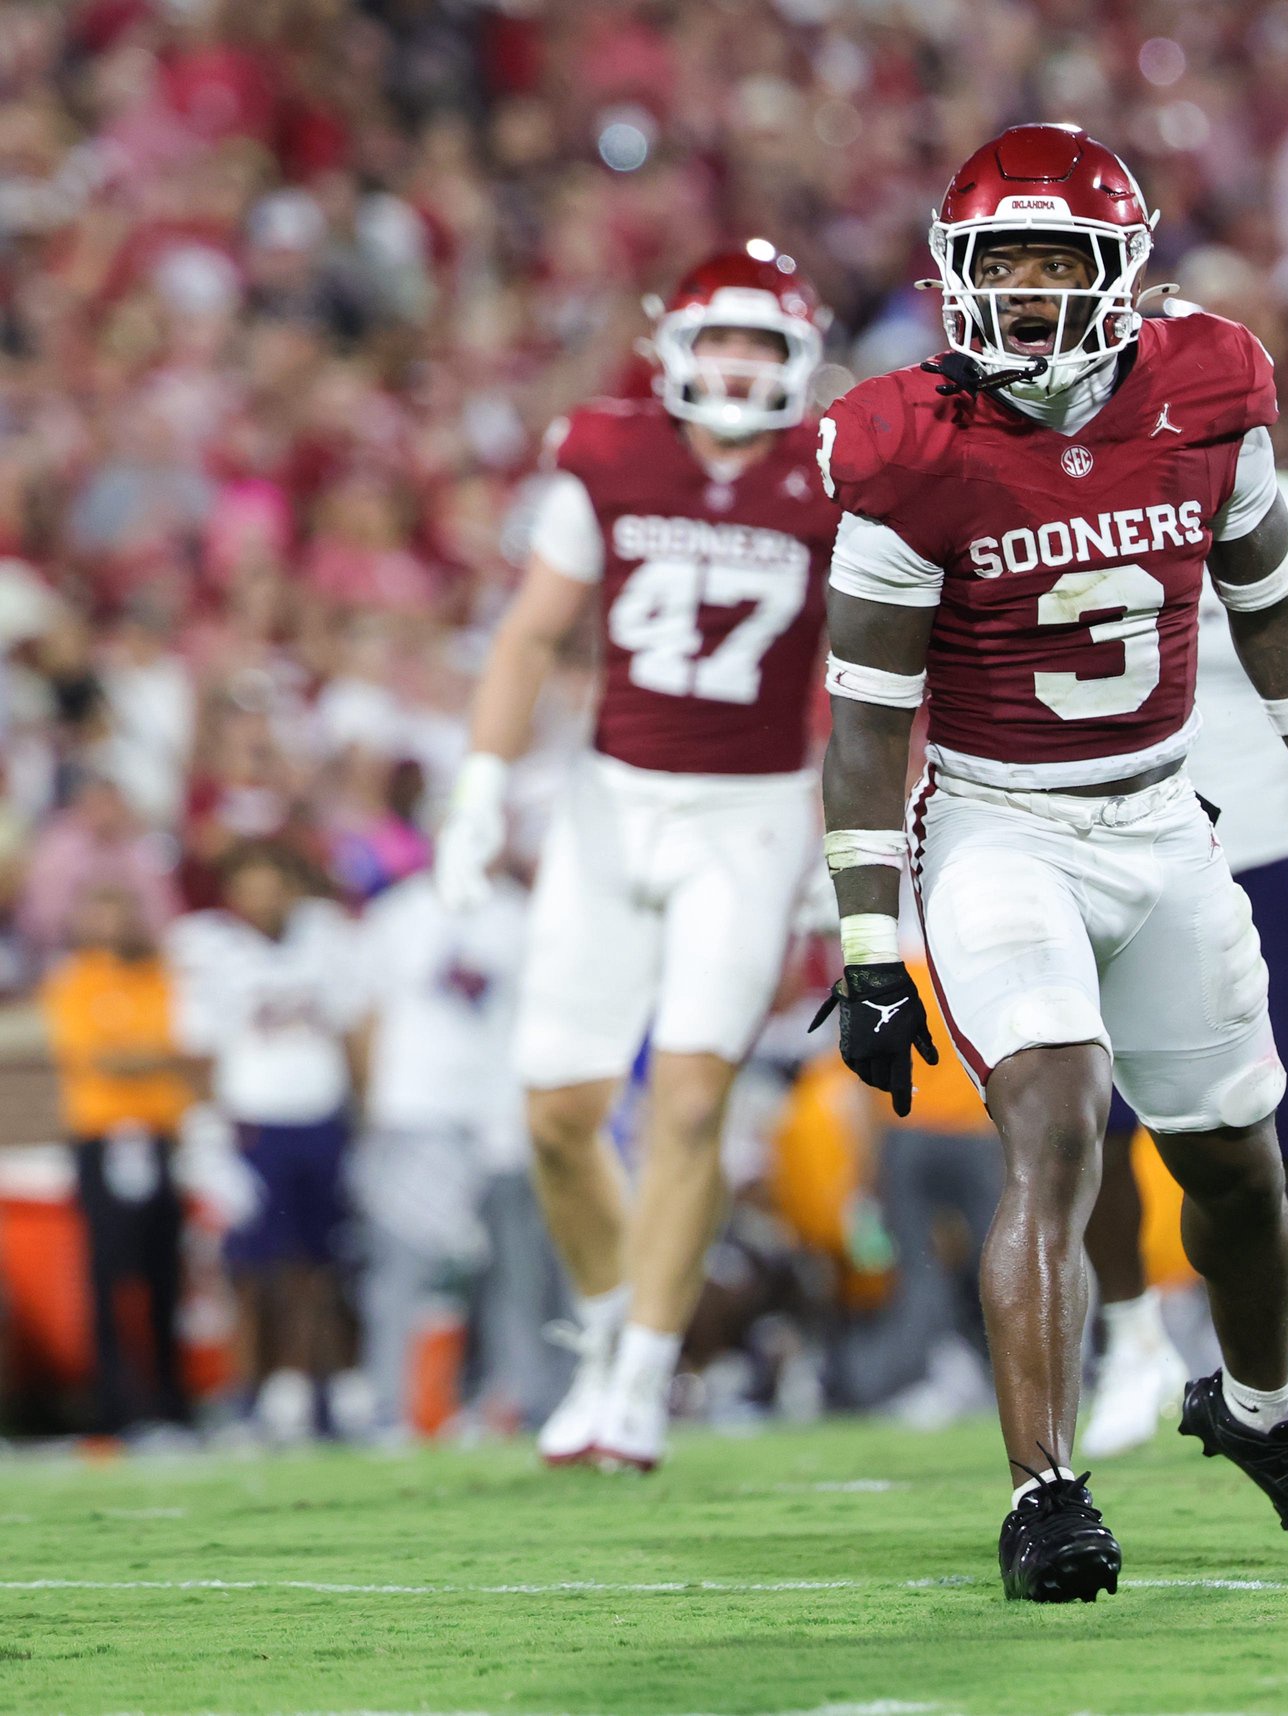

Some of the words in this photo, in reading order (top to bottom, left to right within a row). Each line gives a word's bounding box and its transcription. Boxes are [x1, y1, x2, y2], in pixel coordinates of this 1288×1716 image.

[1011, 200, 1055, 210] OKLAHOMA
[1063, 447, 1091, 476] SEC
[611, 514, 811, 566] SOONERS
[969, 500, 1204, 580] SOONERS
[607, 559, 810, 705] 47
[1034, 563, 1166, 721] 3
